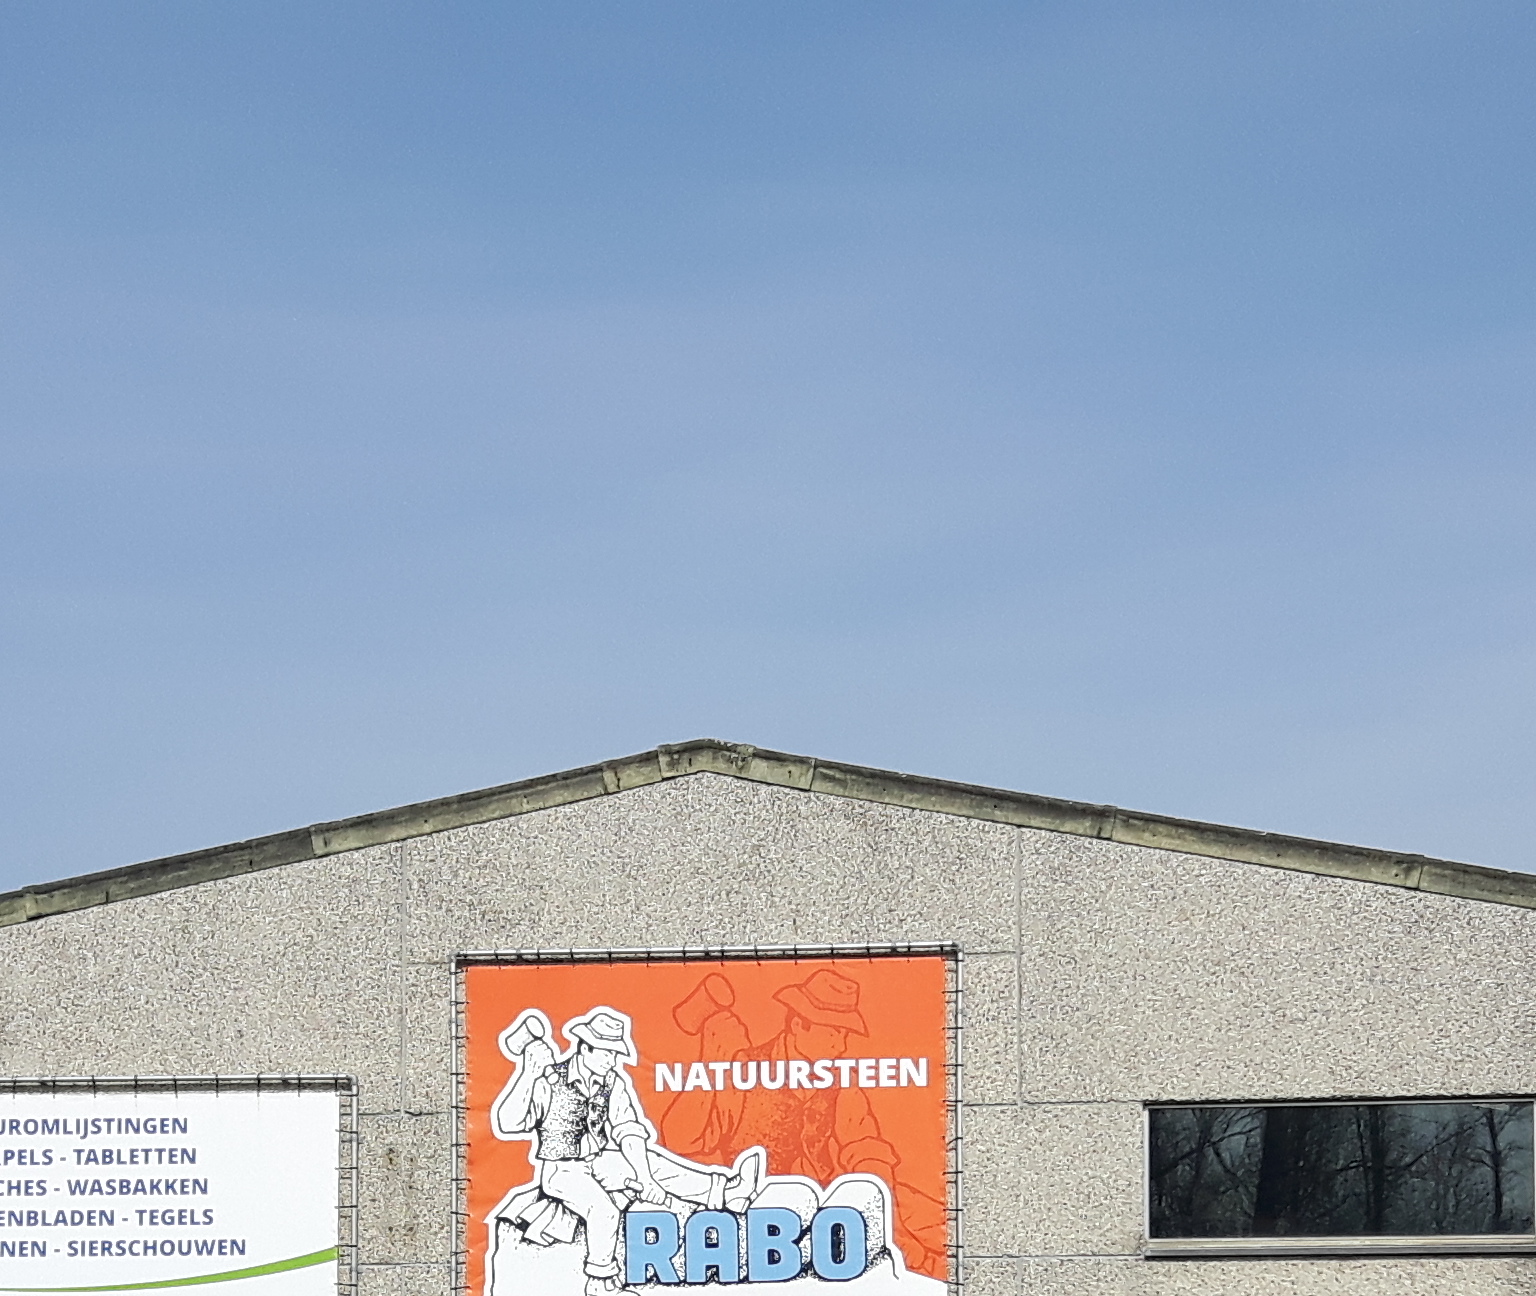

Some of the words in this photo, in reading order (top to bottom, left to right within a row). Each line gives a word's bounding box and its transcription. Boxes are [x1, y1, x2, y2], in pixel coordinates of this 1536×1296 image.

[656, 1058, 927, 1091] NATUURSTEEN
[73, 1148, 196, 1165] TABLETTEN
[67, 1179, 207, 1195] WASBAKKEN
[135, 1209, 213, 1225] TEGELS
[68, 1240, 245, 1257] SIERSCHOUWEN
[622, 1204, 868, 1285] RABO
